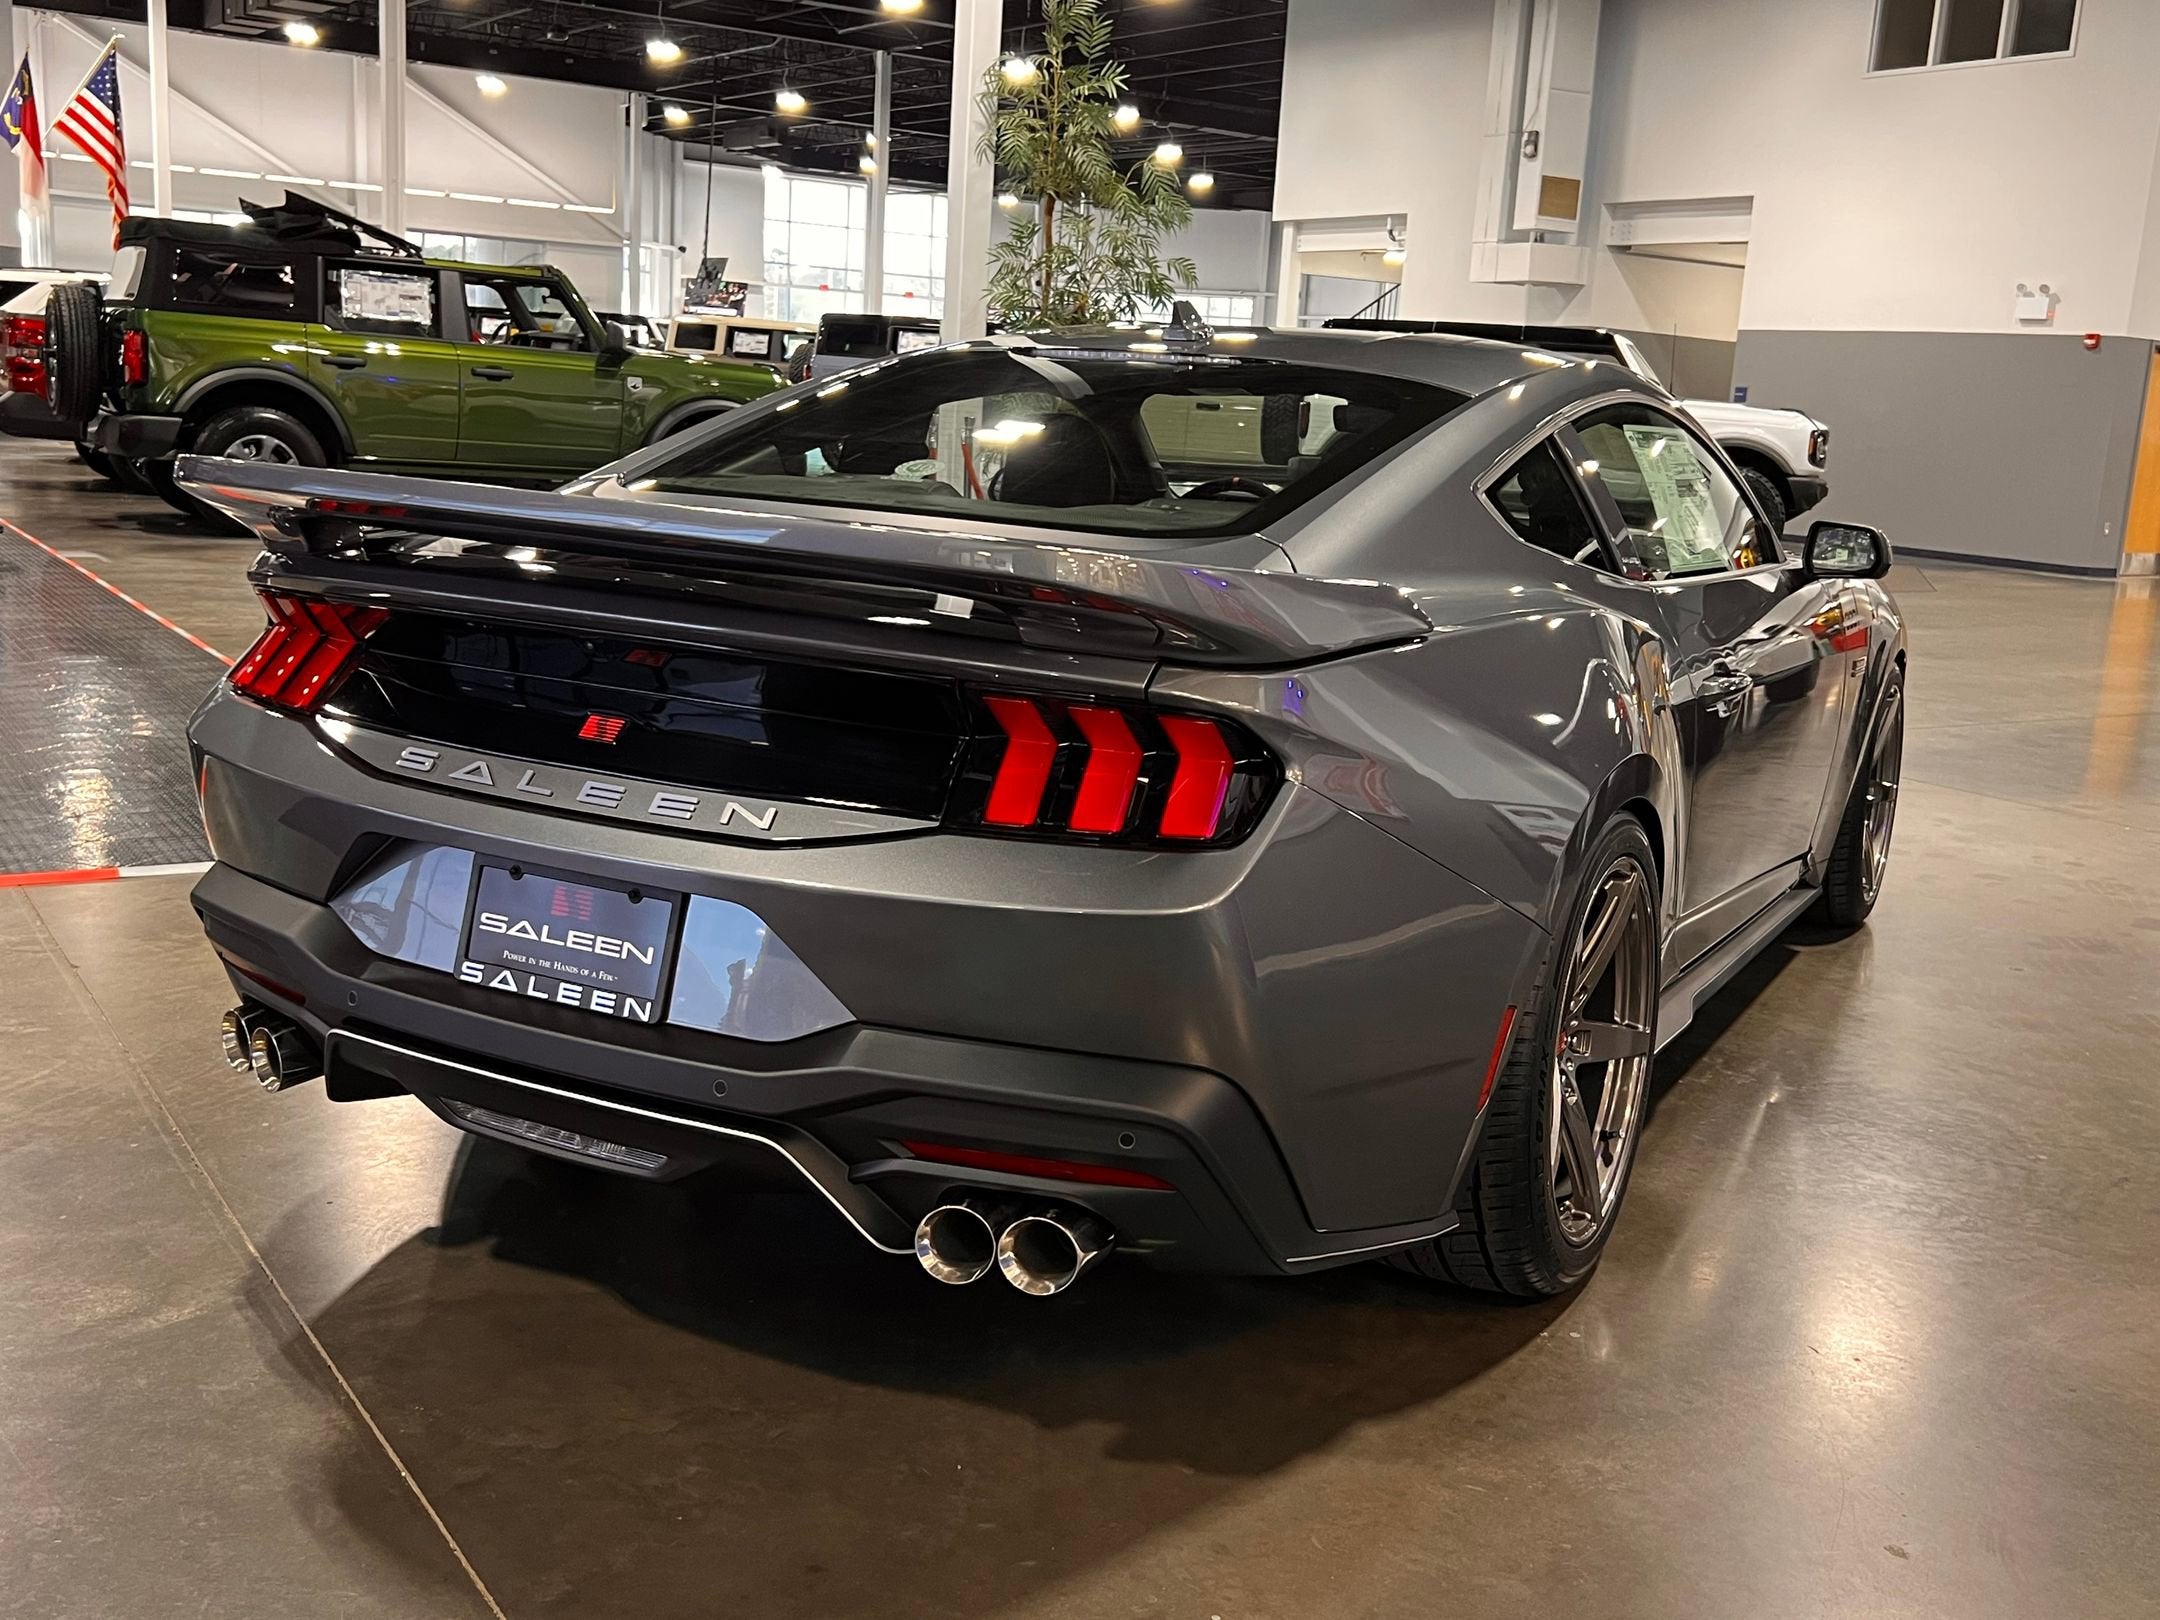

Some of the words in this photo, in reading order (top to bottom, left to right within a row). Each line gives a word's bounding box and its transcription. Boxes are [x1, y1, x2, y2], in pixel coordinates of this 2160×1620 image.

[395, 745, 778, 830] SALEEN
[478, 911, 655, 966] SALEEN
[459, 960, 653, 1023] SALEEN
